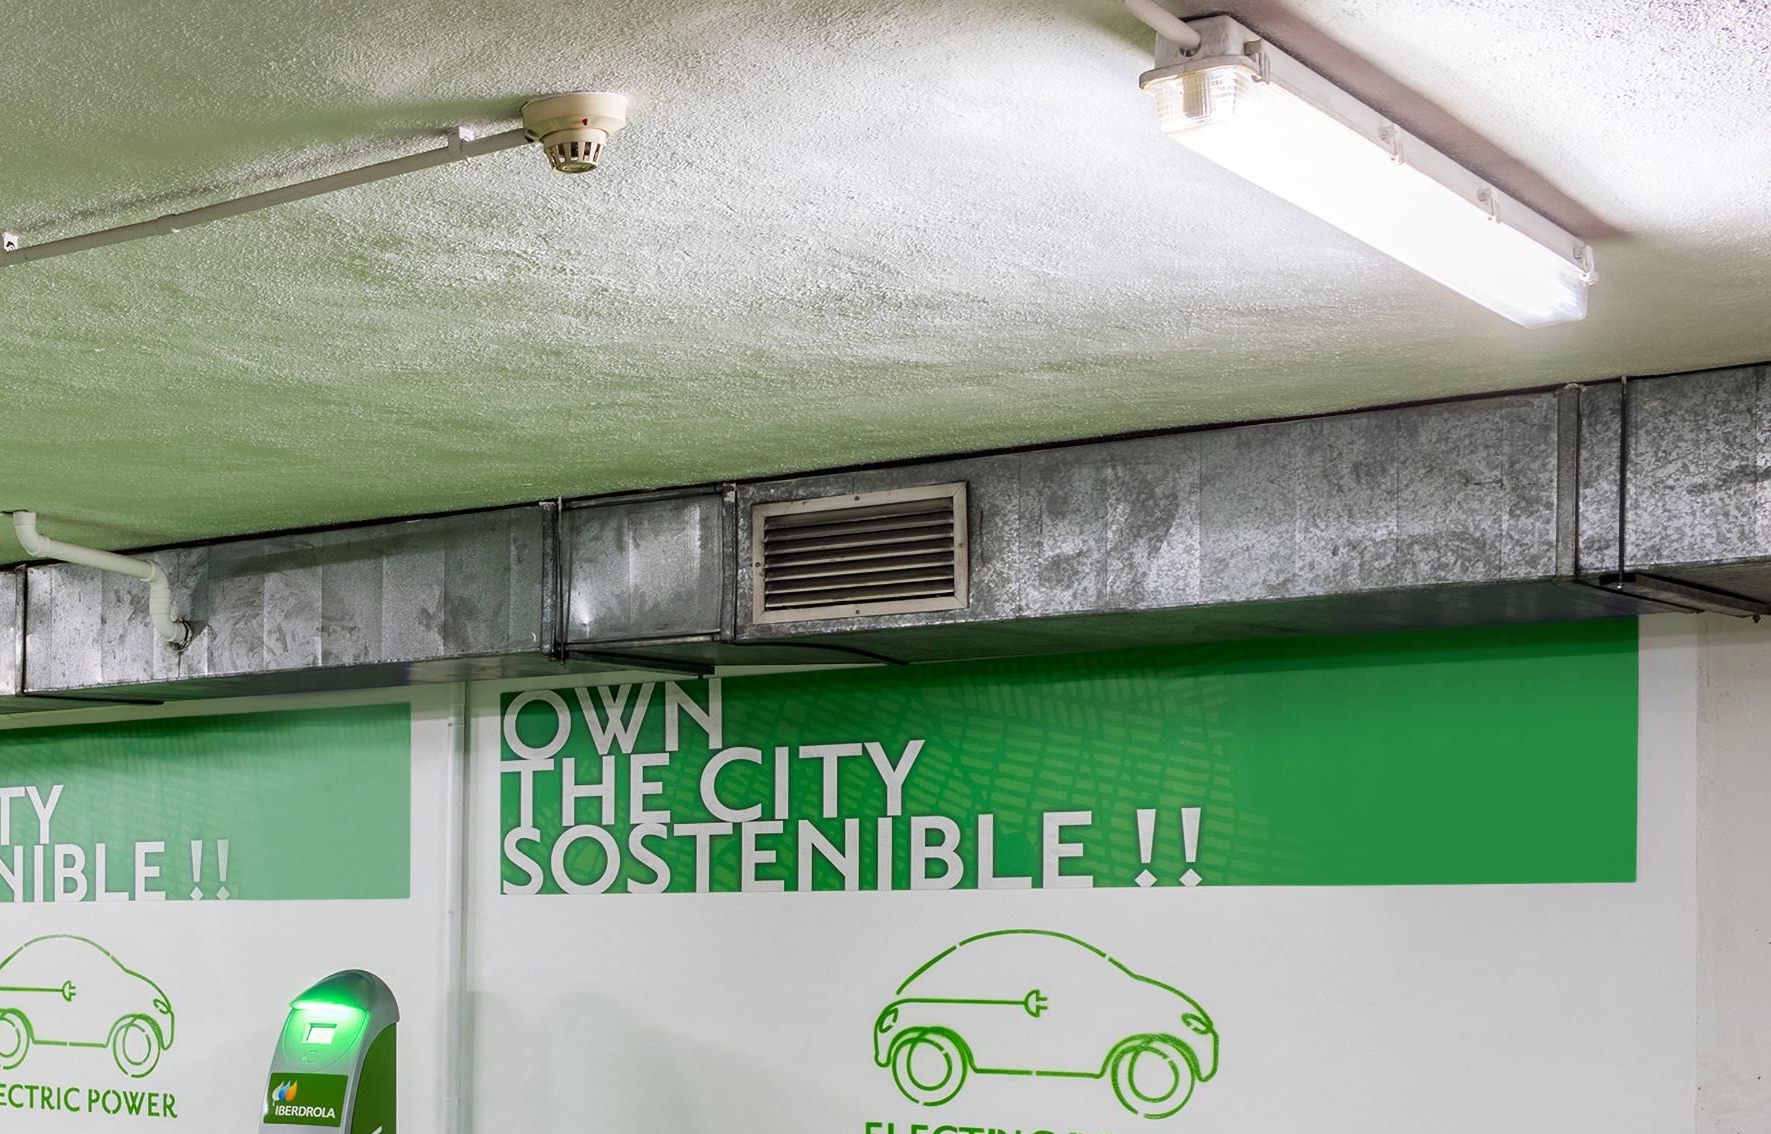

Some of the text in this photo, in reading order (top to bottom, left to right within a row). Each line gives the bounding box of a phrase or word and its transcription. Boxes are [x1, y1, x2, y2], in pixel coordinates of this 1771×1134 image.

[503, 677, 723, 761] OWN
[500, 739, 926, 829] THE CITY
[502, 811, 1094, 896] SOSTENIBLE
[88, 1088, 179, 1119] POWER
[275, 1105, 336, 1119] IBERDROLA
